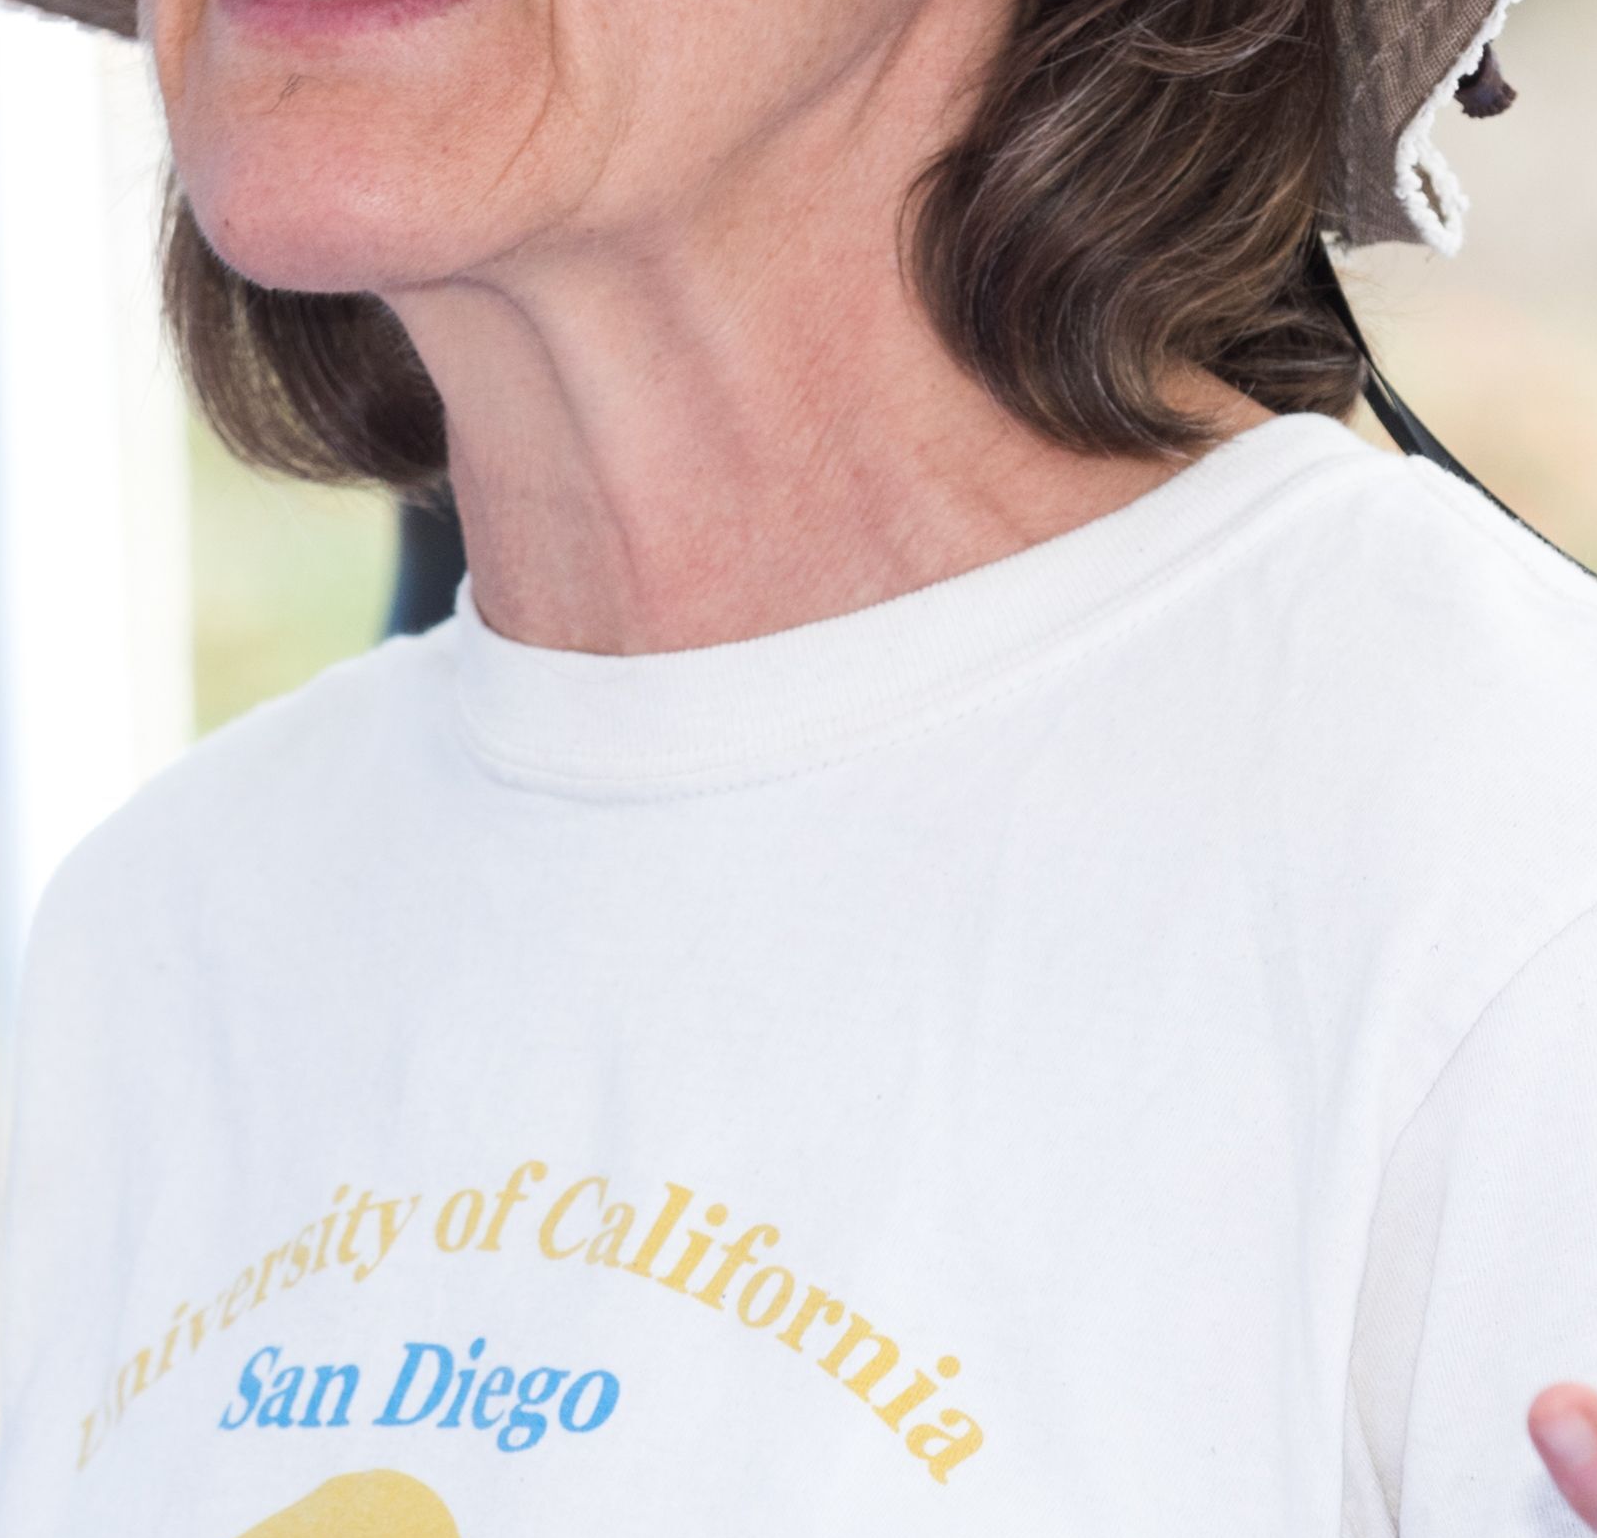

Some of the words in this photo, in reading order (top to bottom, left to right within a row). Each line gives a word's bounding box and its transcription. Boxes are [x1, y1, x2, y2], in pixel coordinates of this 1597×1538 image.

[75, 1183, 423, 1473] University
[434, 1160, 548, 1254] of
[537, 1175, 985, 1485] California
[217, 1345, 361, 1430] San
[371, 1338, 621, 1452] Diego
